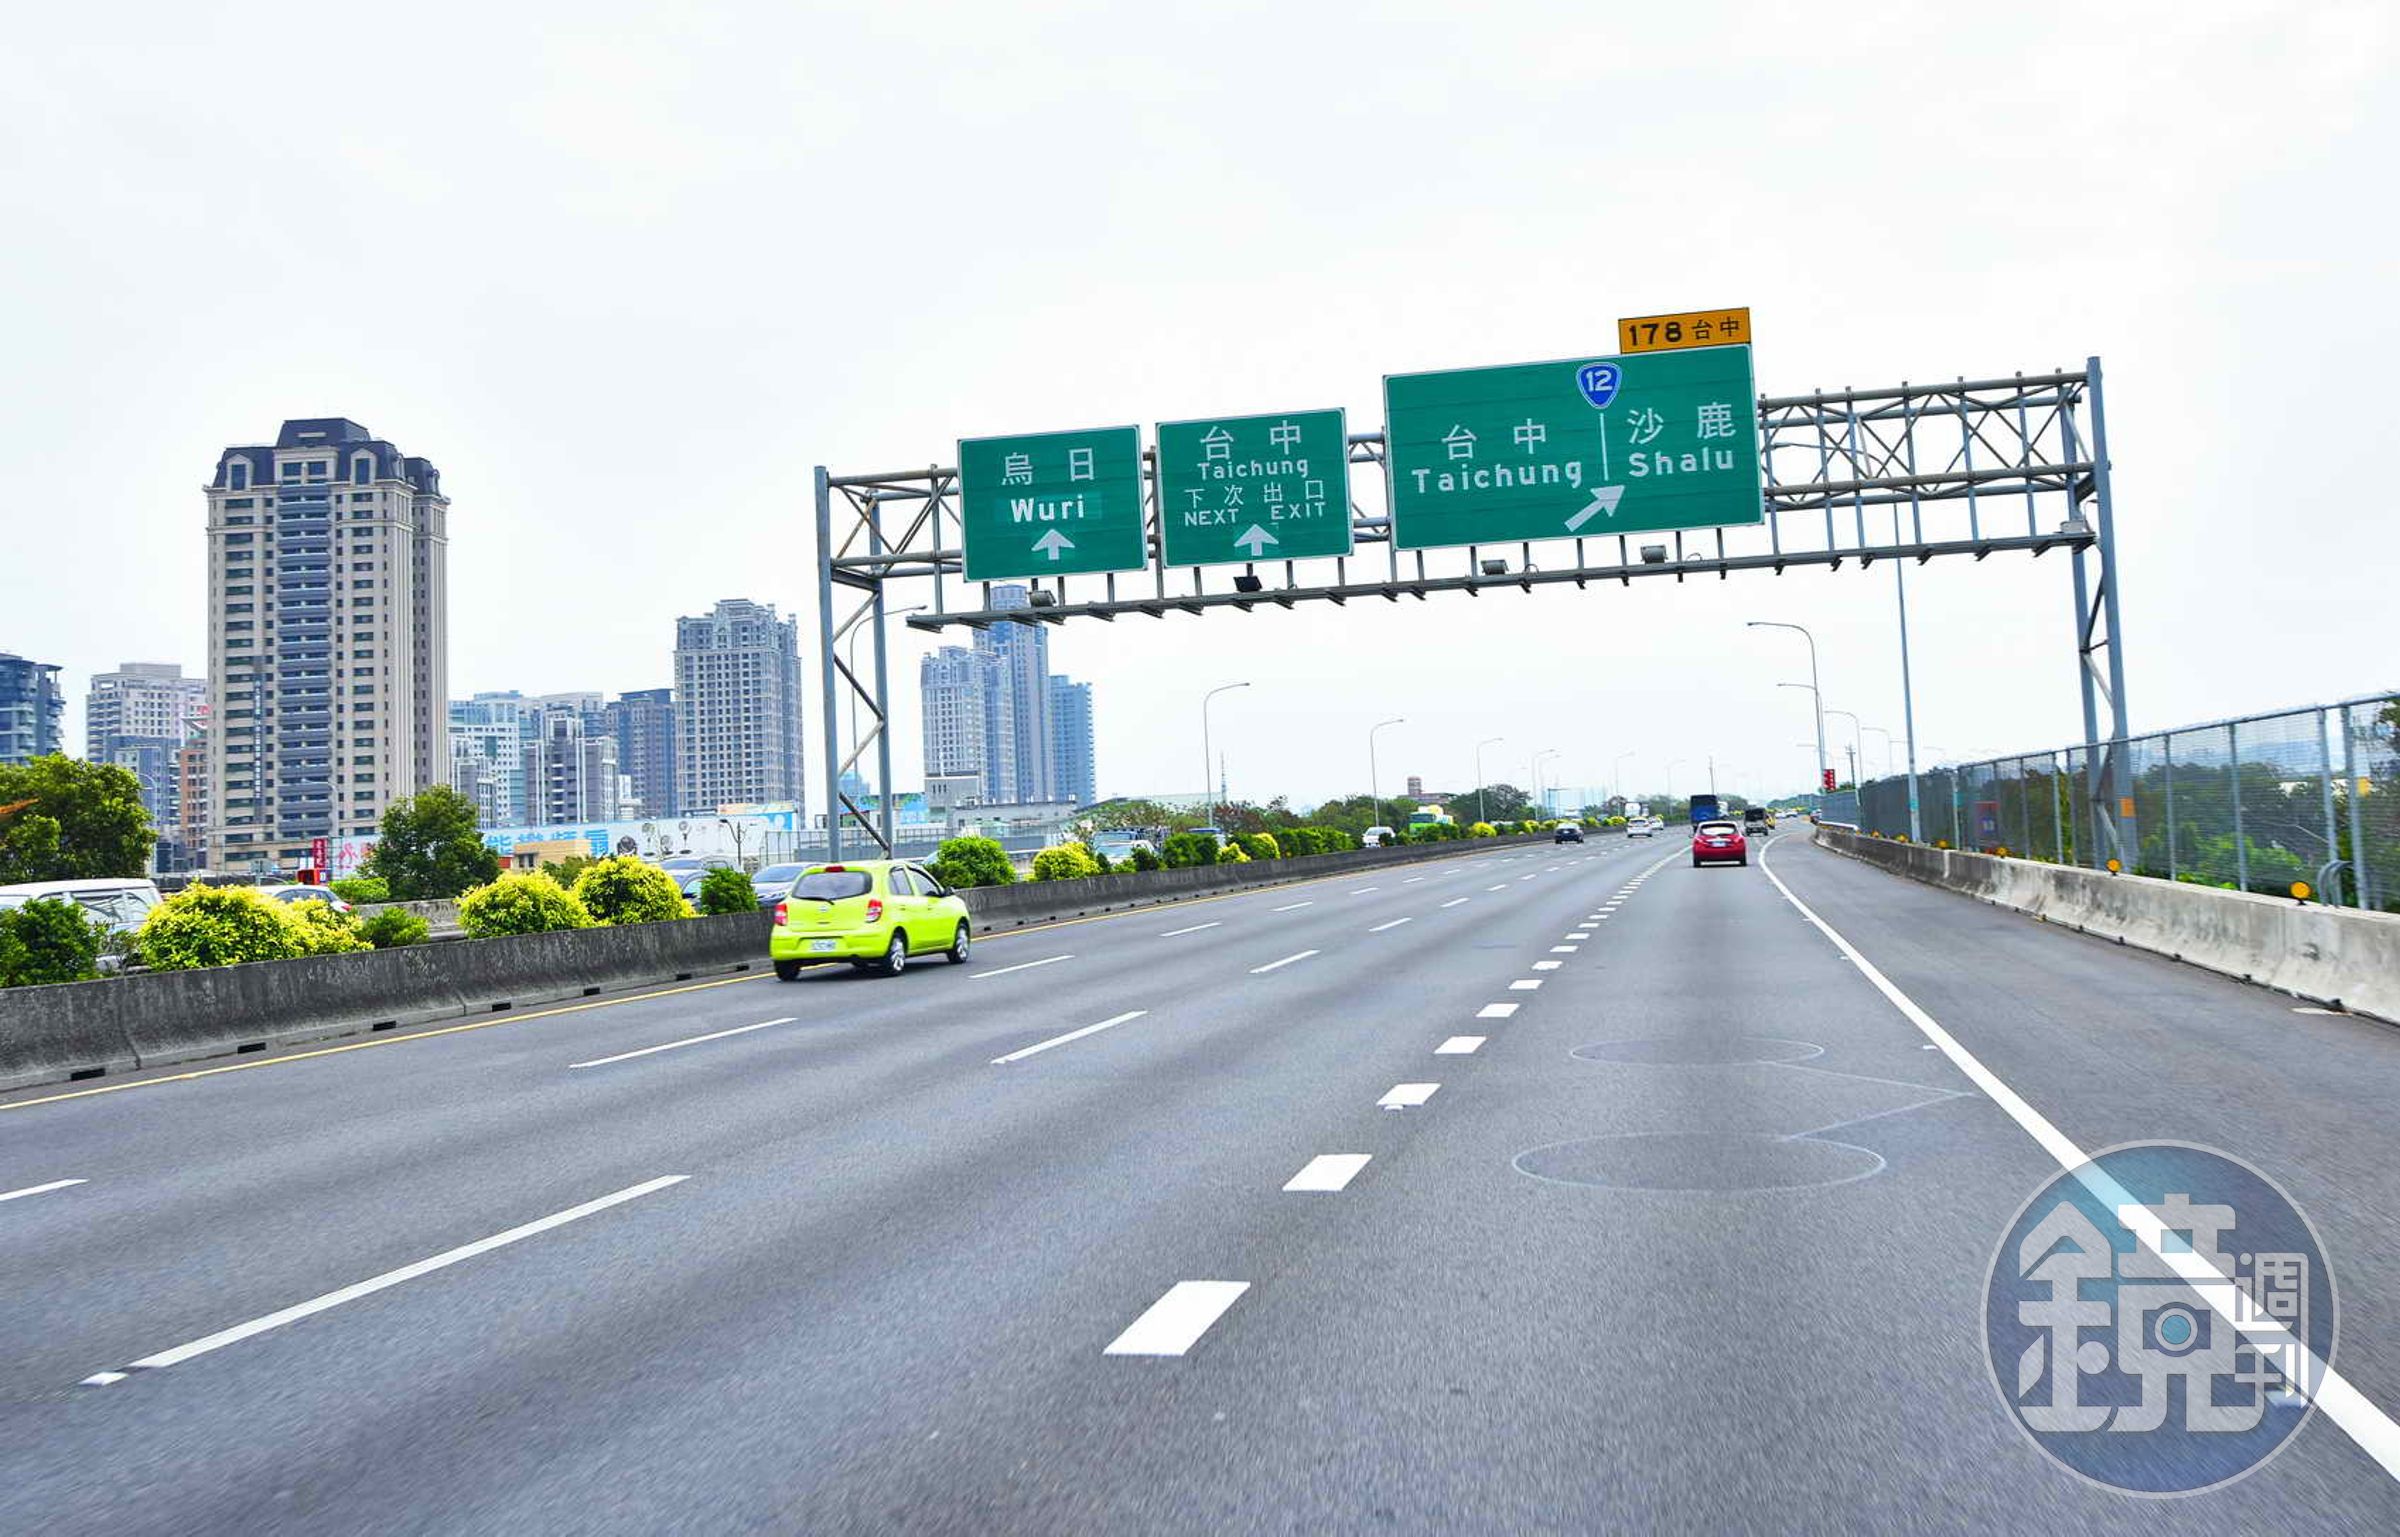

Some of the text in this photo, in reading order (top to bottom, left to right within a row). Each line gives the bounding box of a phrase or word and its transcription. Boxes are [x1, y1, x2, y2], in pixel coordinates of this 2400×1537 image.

[1628, 315, 1741, 347] 178 台中
[1585, 369, 1613, 393] 12
[1626, 401, 1737, 445] 沙鹿
[1200, 419, 1302, 462] 台中
[1441, 418, 1547, 461] 台中
[1002, 447, 1095, 486] 烏日
[1197, 459, 1309, 481] Taichung
[1411, 460, 1583, 494] Taichung
[1628, 446, 1735, 478] Shalu
[1010, 494, 1085, 524] Wuri
[1184, 501, 1327, 527] NEXT EXIT
